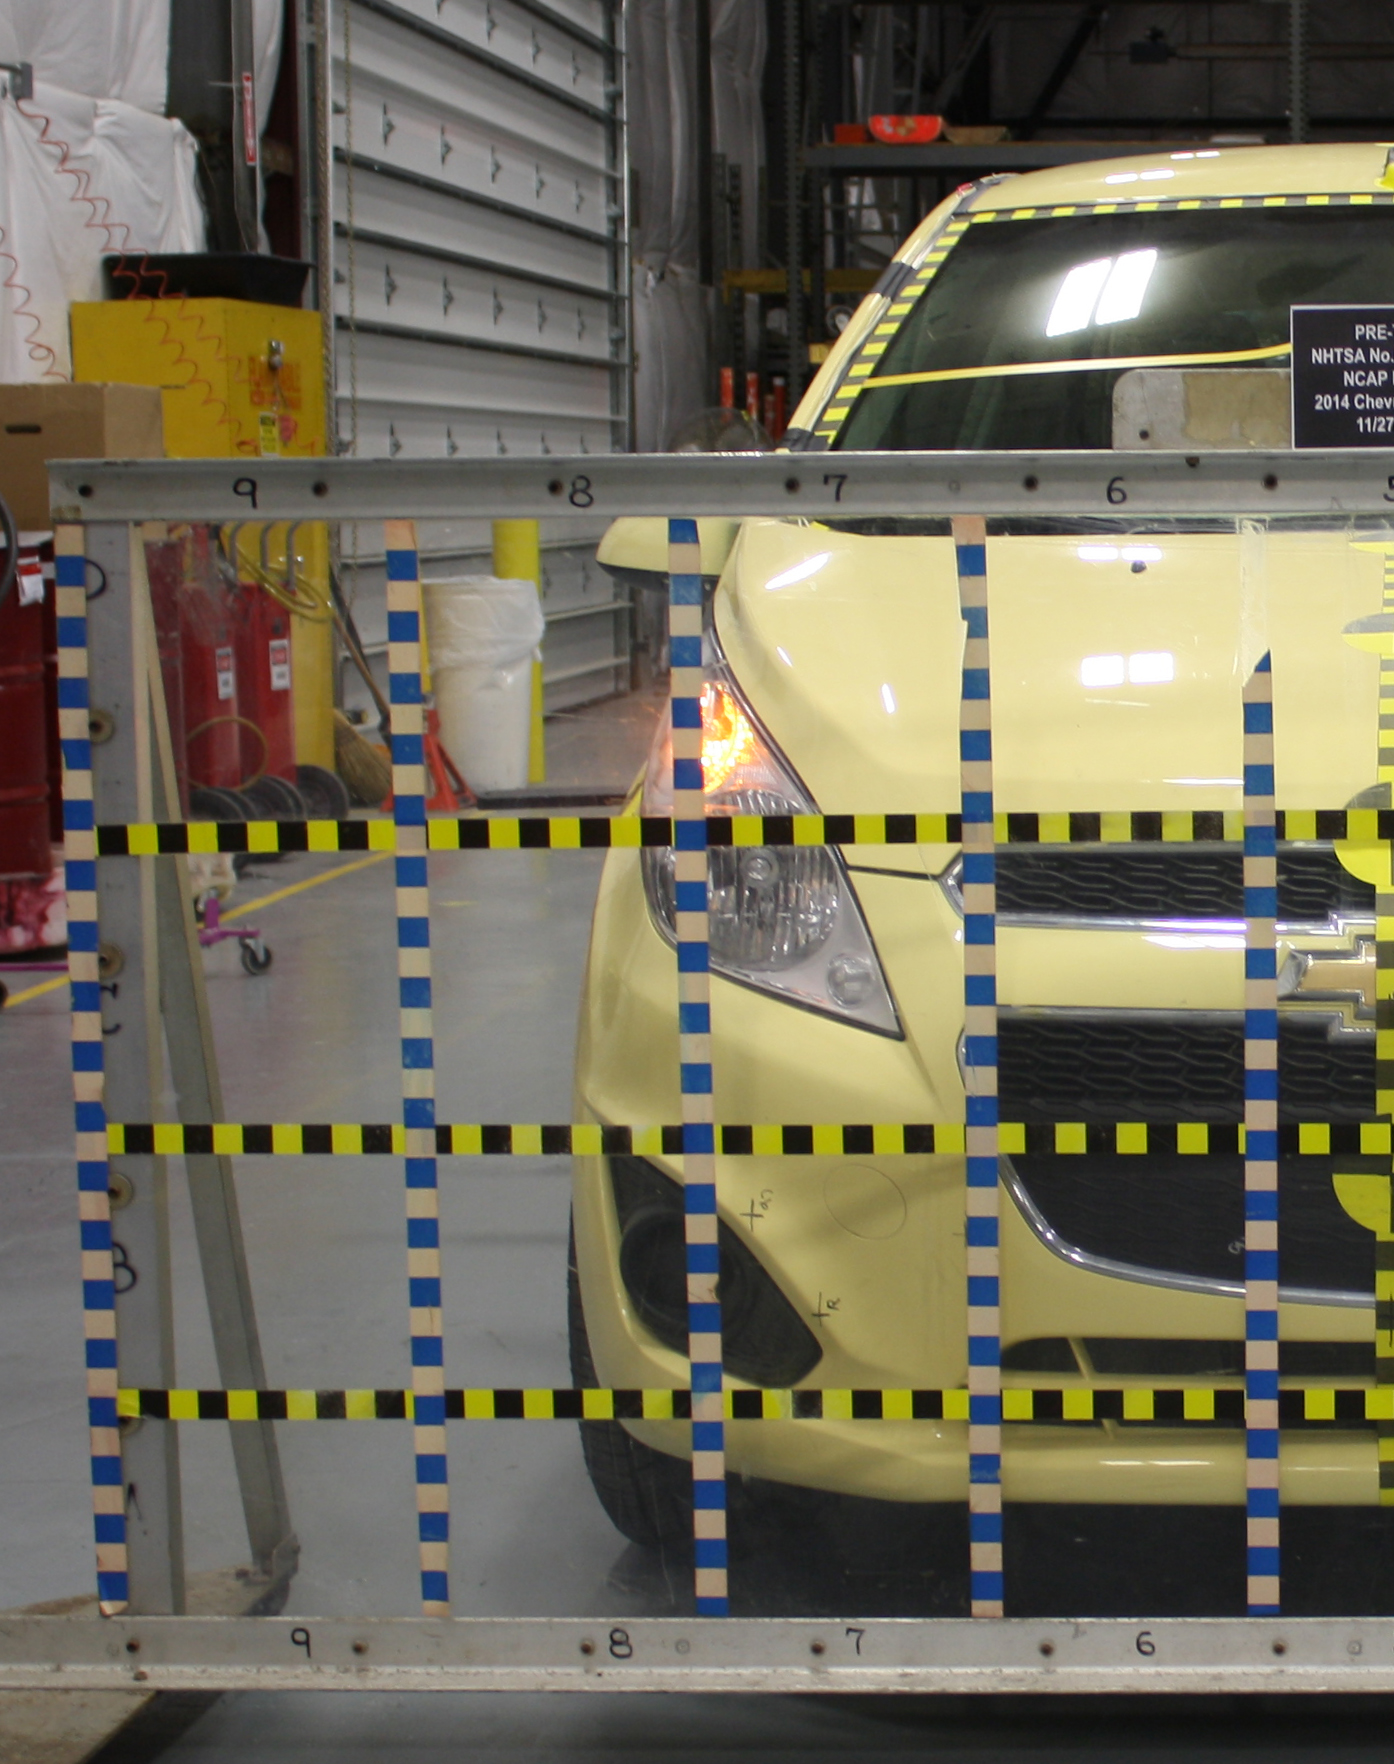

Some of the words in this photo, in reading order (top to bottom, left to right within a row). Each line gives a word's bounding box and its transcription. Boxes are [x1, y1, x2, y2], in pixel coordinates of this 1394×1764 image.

[1311, 348, 1366, 364] NHTSA
[1344, 371, 1388, 387] NCAP
[1314, 394, 1350, 410] 2014
[233, 477, 257, 508] 9
[569, 475, 593, 507] 8
[823, 473, 848, 501] 7
[1107, 476, 1126, 503] 6
[291, 1628, 310, 1657] 9
[610, 1628, 632, 1658] 8
[846, 1627, 865, 1655] 7
[1136, 1631, 1155, 1656] 6
